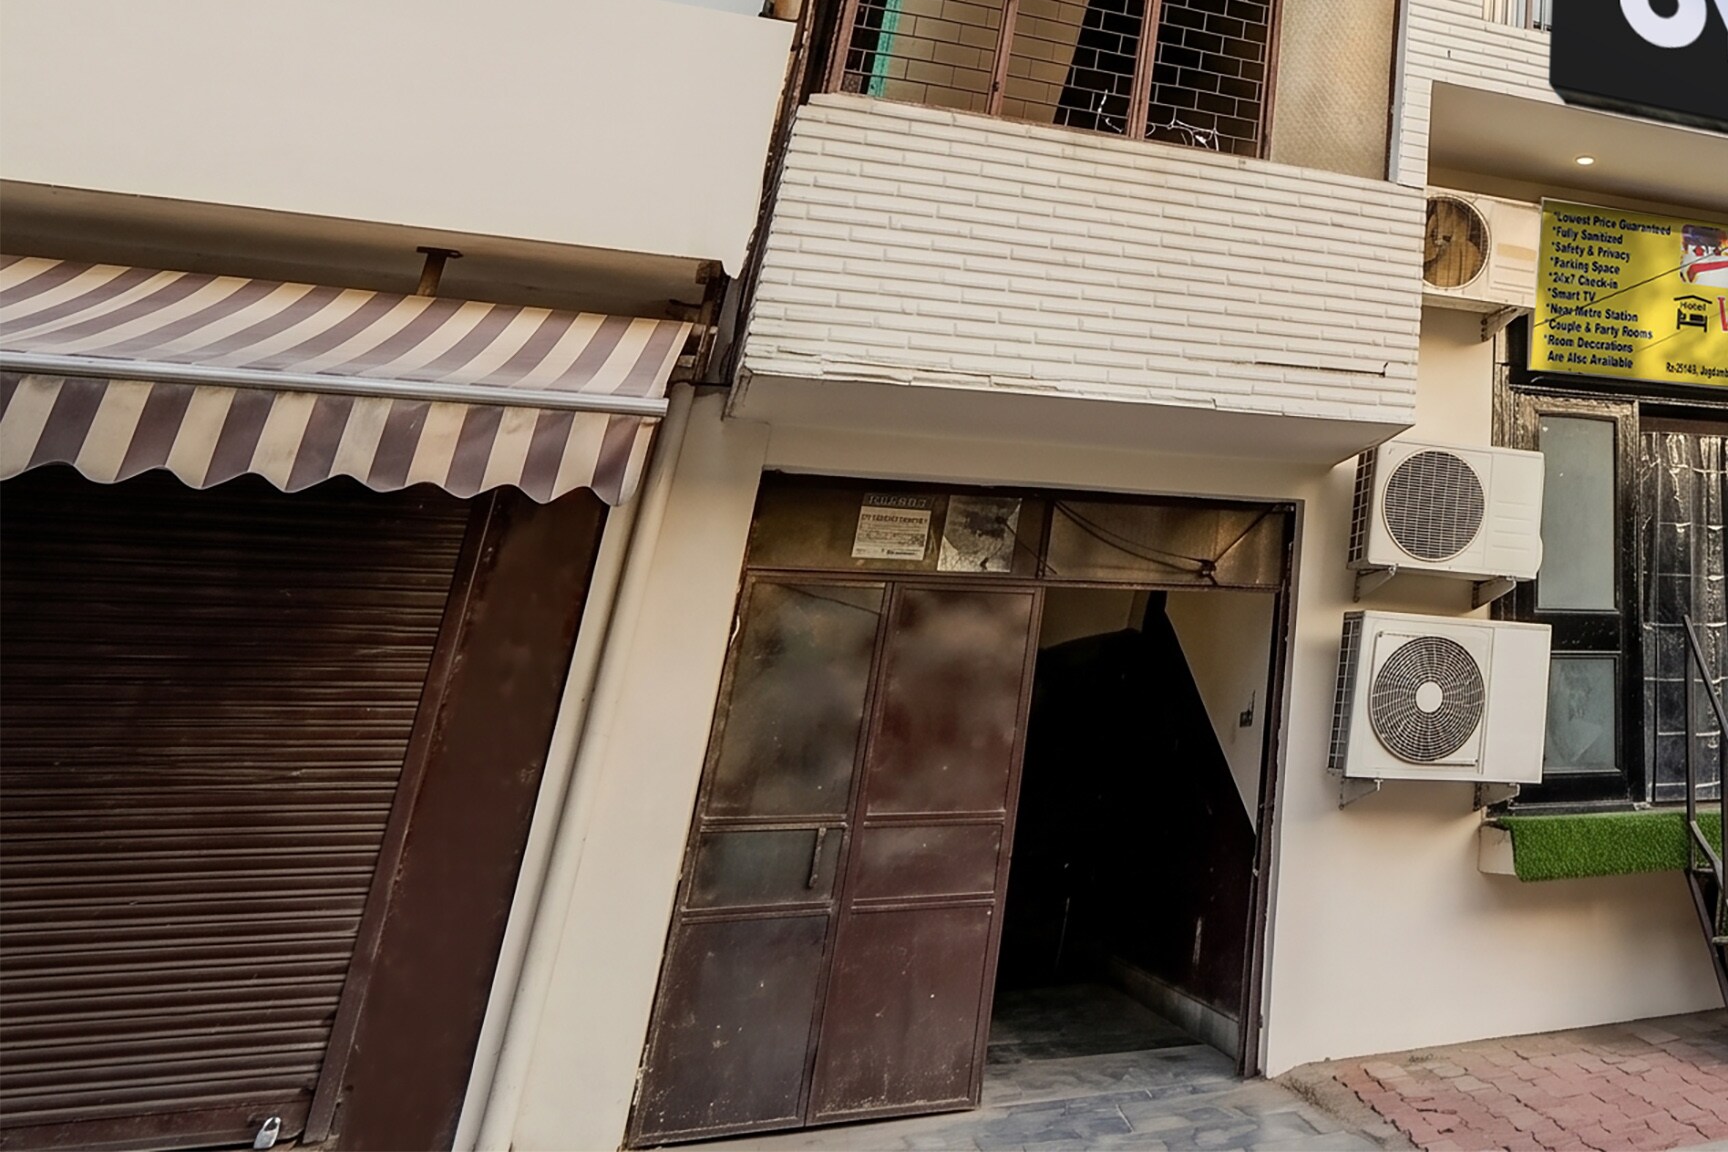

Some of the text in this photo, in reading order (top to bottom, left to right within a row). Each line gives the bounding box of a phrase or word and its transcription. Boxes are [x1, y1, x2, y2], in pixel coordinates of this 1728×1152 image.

[1556, 213, 1672, 236] Lowest Price Guaranteed
[1556, 226, 1624, 245] Fully Sanitized
[1555, 241, 1631, 263] Safety & Privacy
[1553, 256, 1621, 275] Parking Space
[1552, 272, 1619, 289] 24x7 Check-in
[1551, 287, 1597, 302] Smart TV
[1550, 303, 1639, 322] Near Metro Station
[1679, 301, 1707, 312] Hotel
[1548, 318, 1654, 340] Couple & Party Rooms
[1547, 334, 1634, 354] Room Decorations
[1547, 350, 1634, 369] Are Also Available
